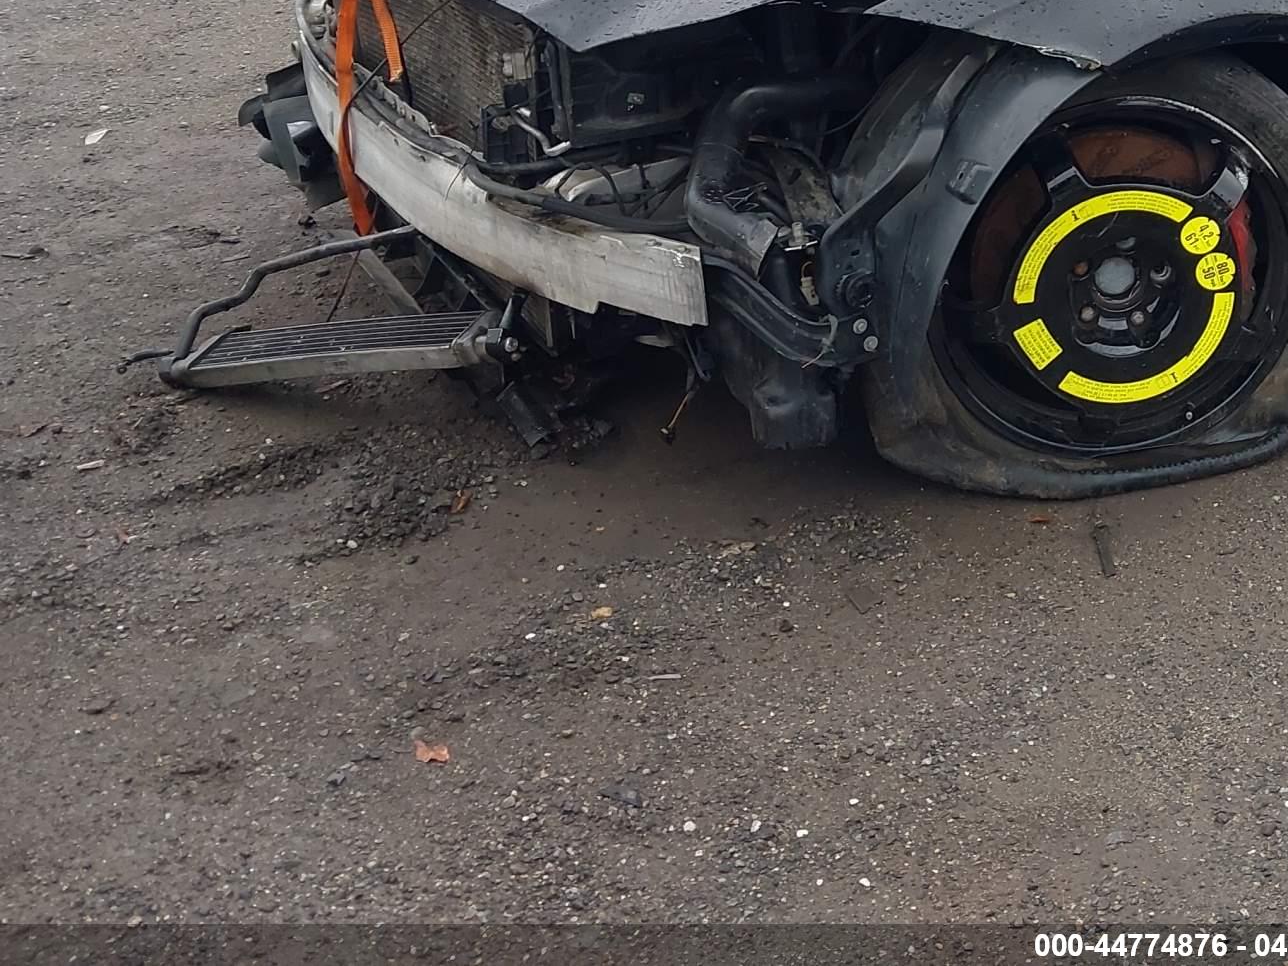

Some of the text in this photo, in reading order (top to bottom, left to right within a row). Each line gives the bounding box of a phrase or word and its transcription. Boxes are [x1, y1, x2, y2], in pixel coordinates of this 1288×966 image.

[1185, 232, 1200, 246] 61
[1202, 266, 1216, 280] 50
[1216, 261, 1230, 276] 80
